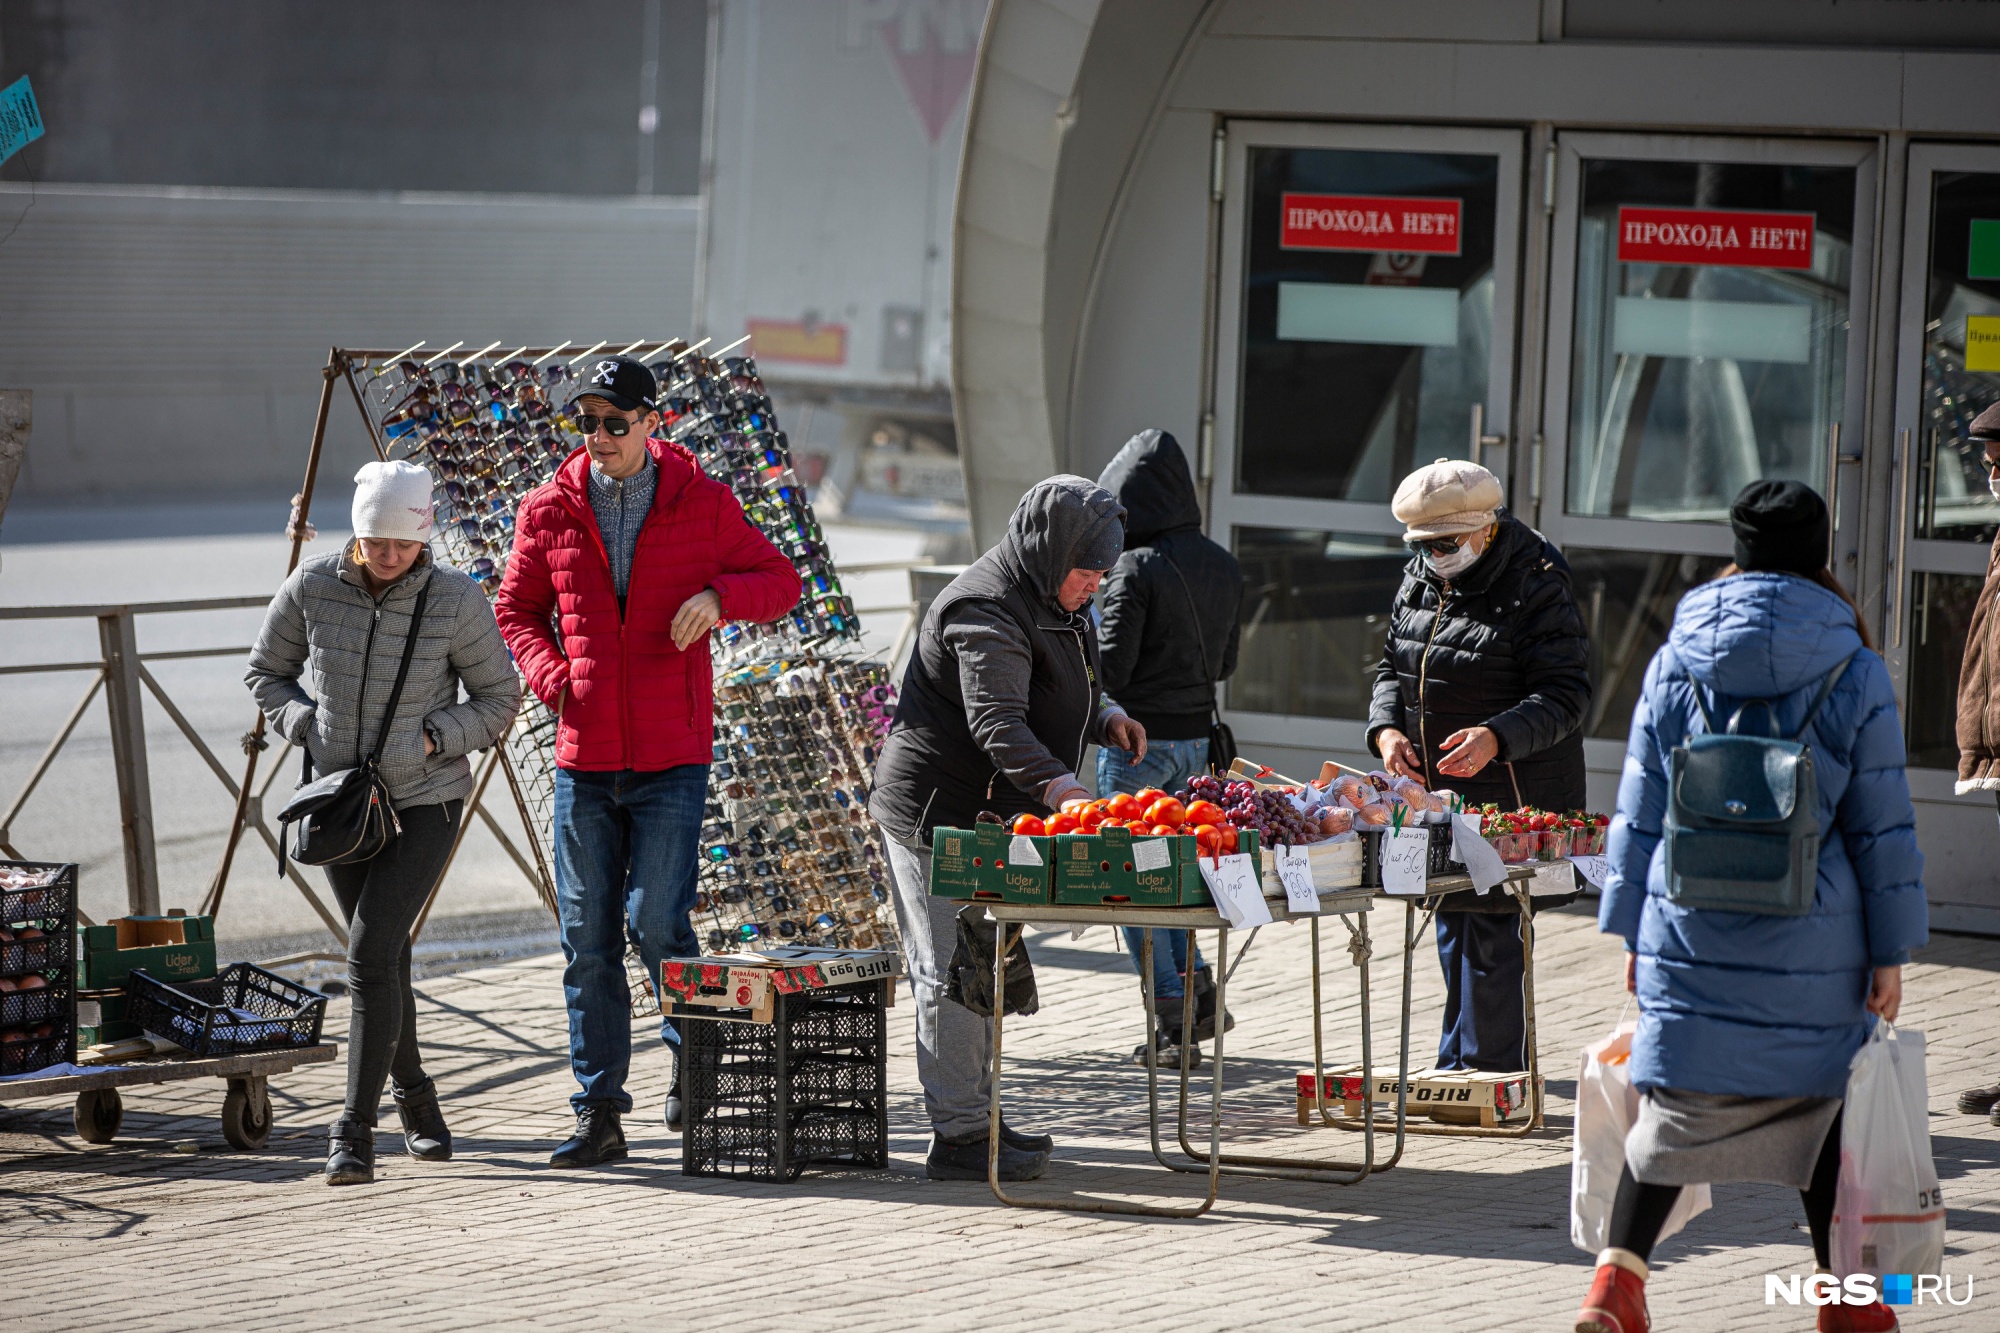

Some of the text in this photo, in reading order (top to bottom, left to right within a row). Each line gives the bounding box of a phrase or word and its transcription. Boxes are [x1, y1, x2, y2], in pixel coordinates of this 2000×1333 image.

[1287, 207, 1456, 236] ПРОХОДА НЕТ!
[1625, 221, 1807, 251] ПРОХОДА НЕТ!
[1006, 873, 1034, 886] Lider
[1136, 874, 1165, 886] Lider
[166, 953, 193, 967] Lider
[829, 958, 892, 978] RIFO 999
[738, 978, 752, 987] Taze
[1416, 1088, 1472, 1102] RIFO
